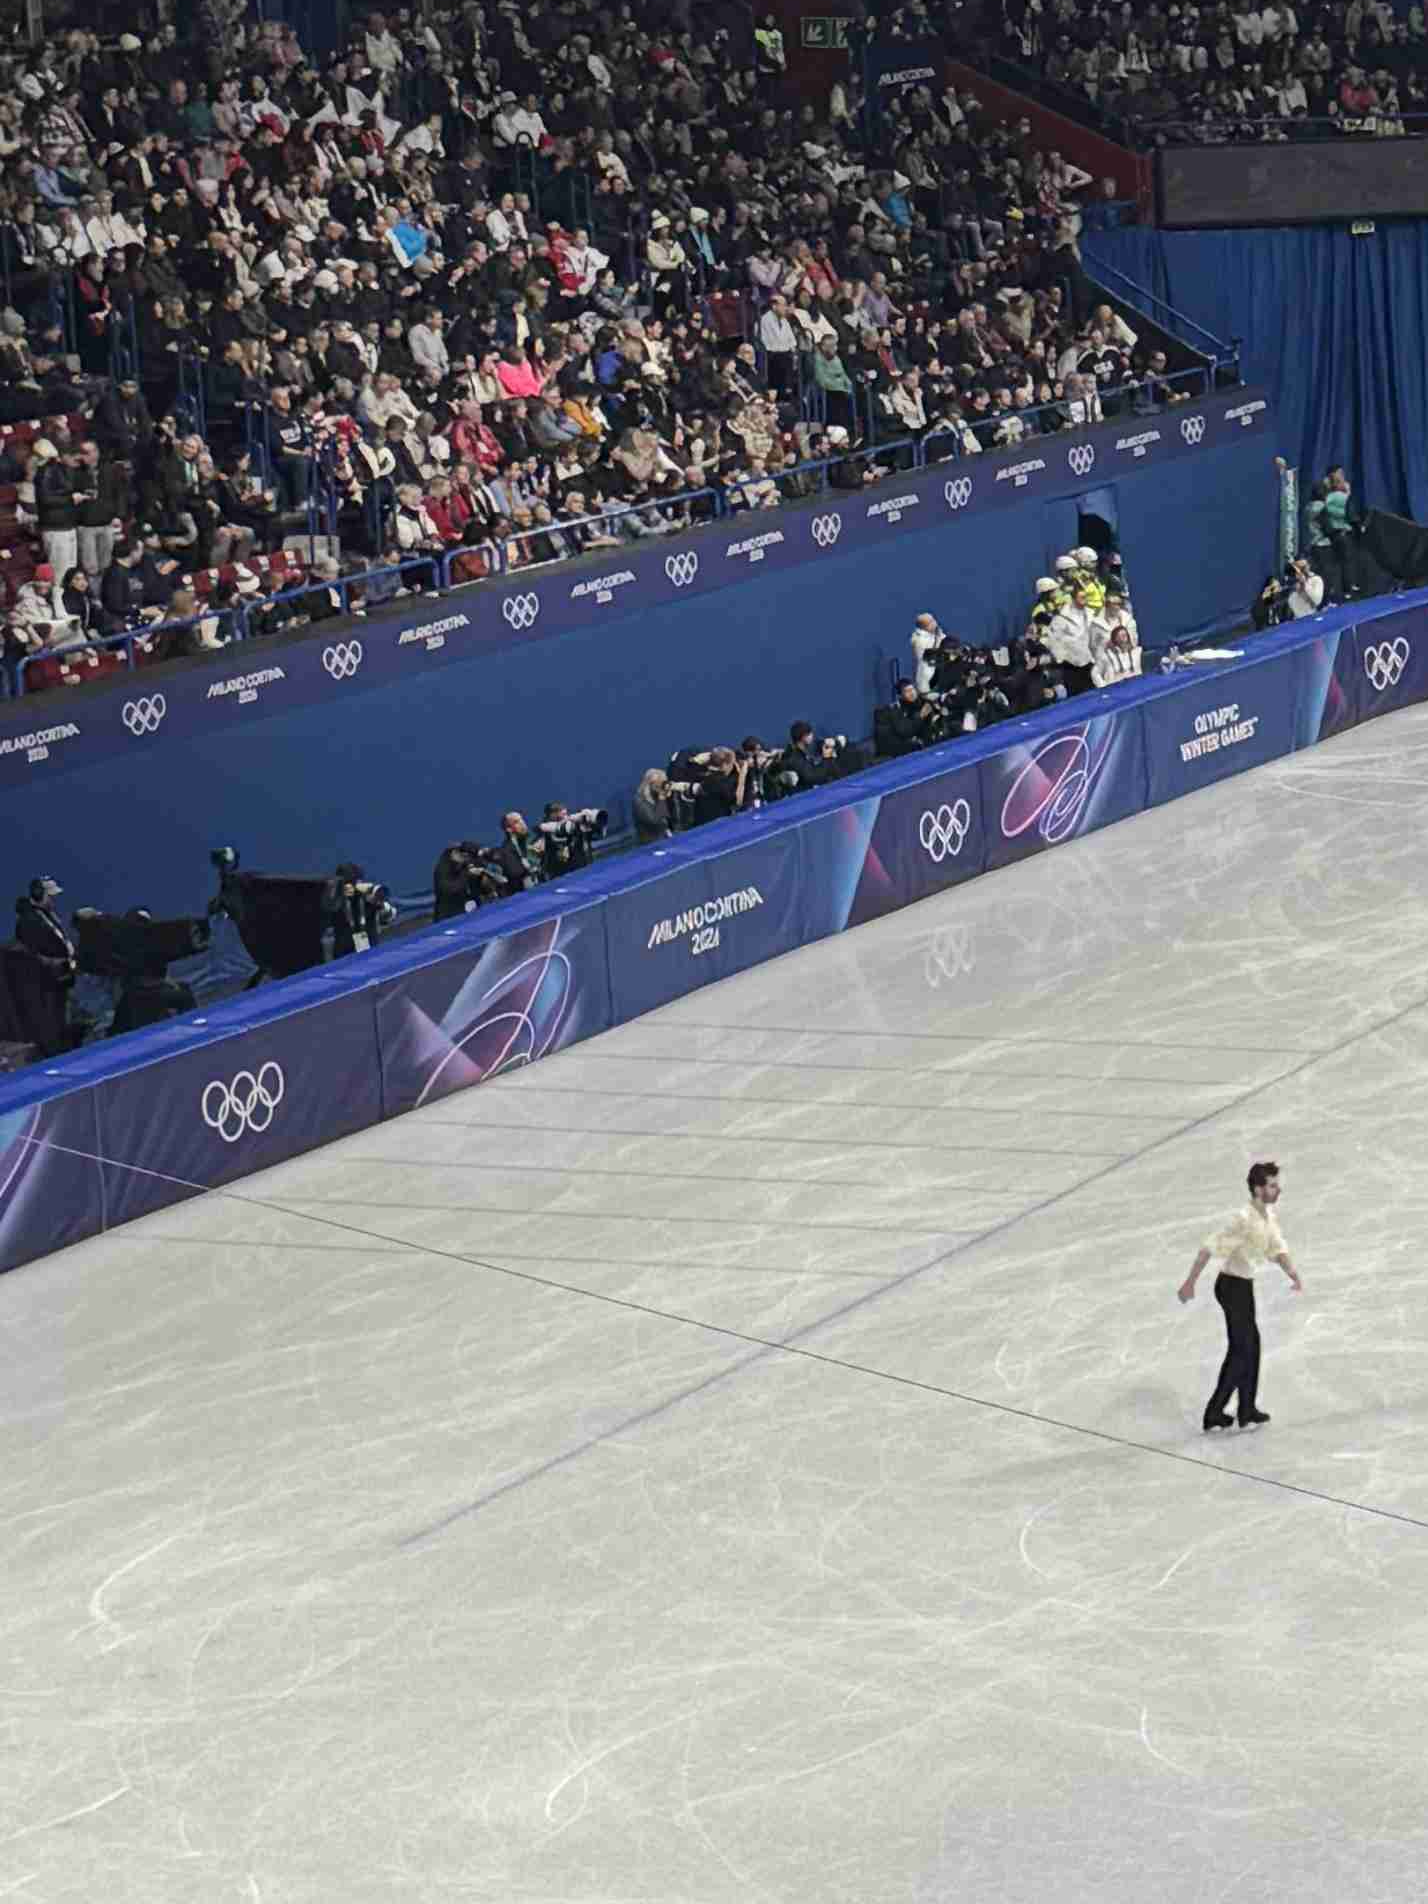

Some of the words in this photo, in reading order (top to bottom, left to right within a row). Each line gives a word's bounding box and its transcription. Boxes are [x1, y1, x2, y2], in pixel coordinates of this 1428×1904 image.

[1194, 703, 1241, 734] OLYMPIC
[1180, 731, 1220, 763] WINTER
[647, 906, 705, 950] MILANO
[704, 885, 764, 924] CORTINA
